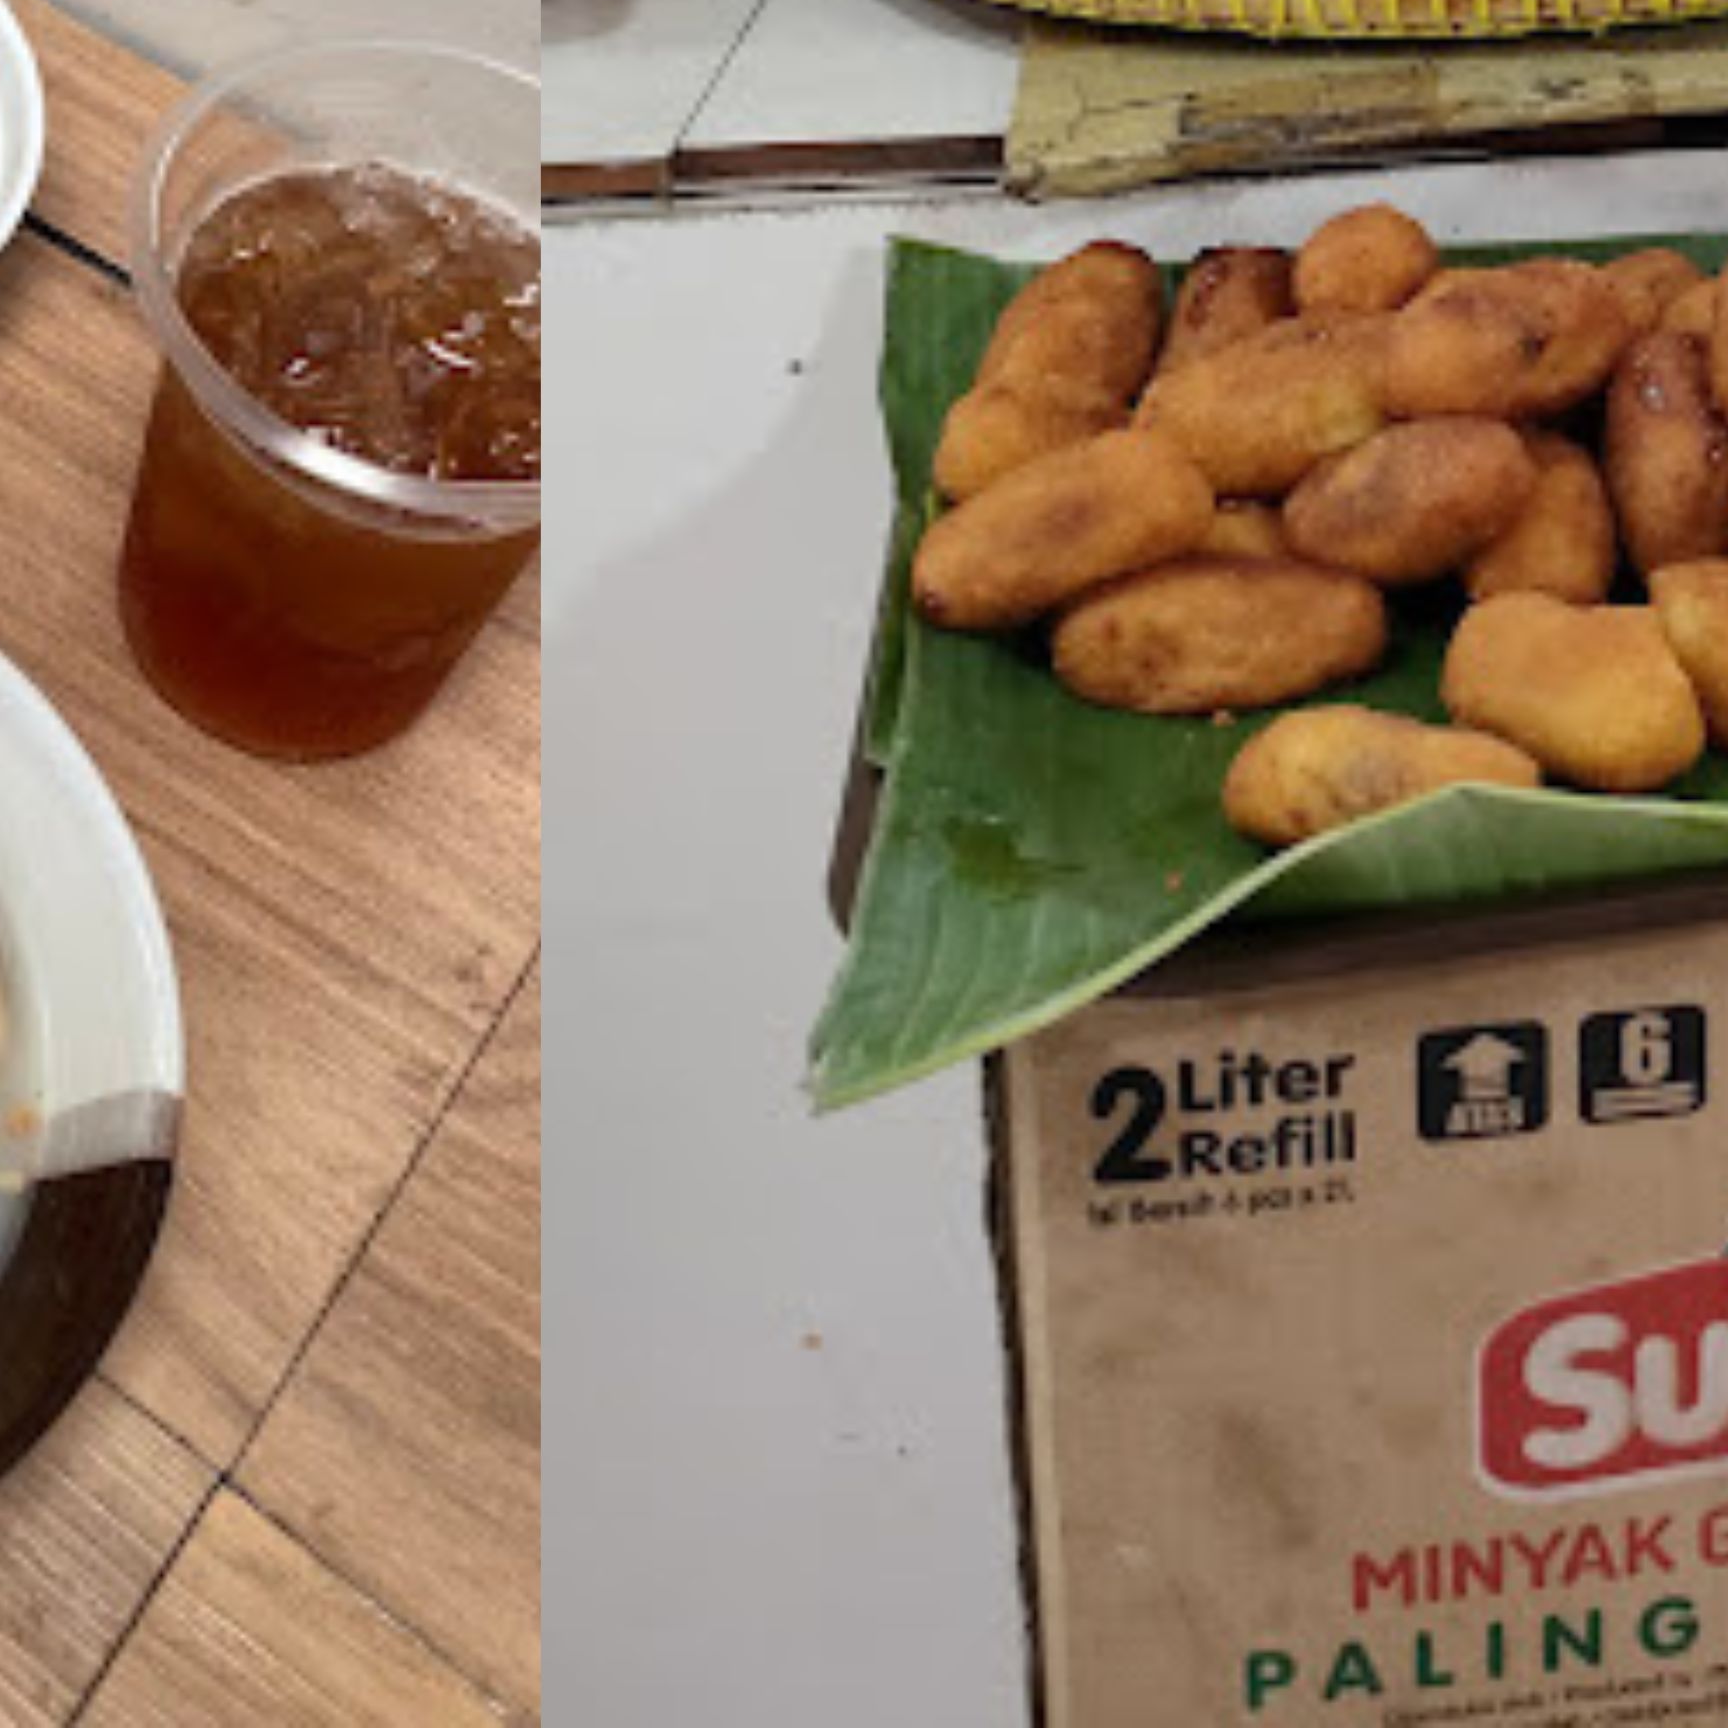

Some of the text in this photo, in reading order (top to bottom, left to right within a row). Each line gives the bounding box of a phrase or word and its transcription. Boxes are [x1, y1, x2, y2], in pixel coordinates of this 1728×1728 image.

[1090, 1049, 1355, 1186] 2 Liter
[1177, 1108, 1356, 1178] Refill
[1350, 1515, 1676, 1612] MINYAK
[1246, 1596, 1700, 1708] PALING
